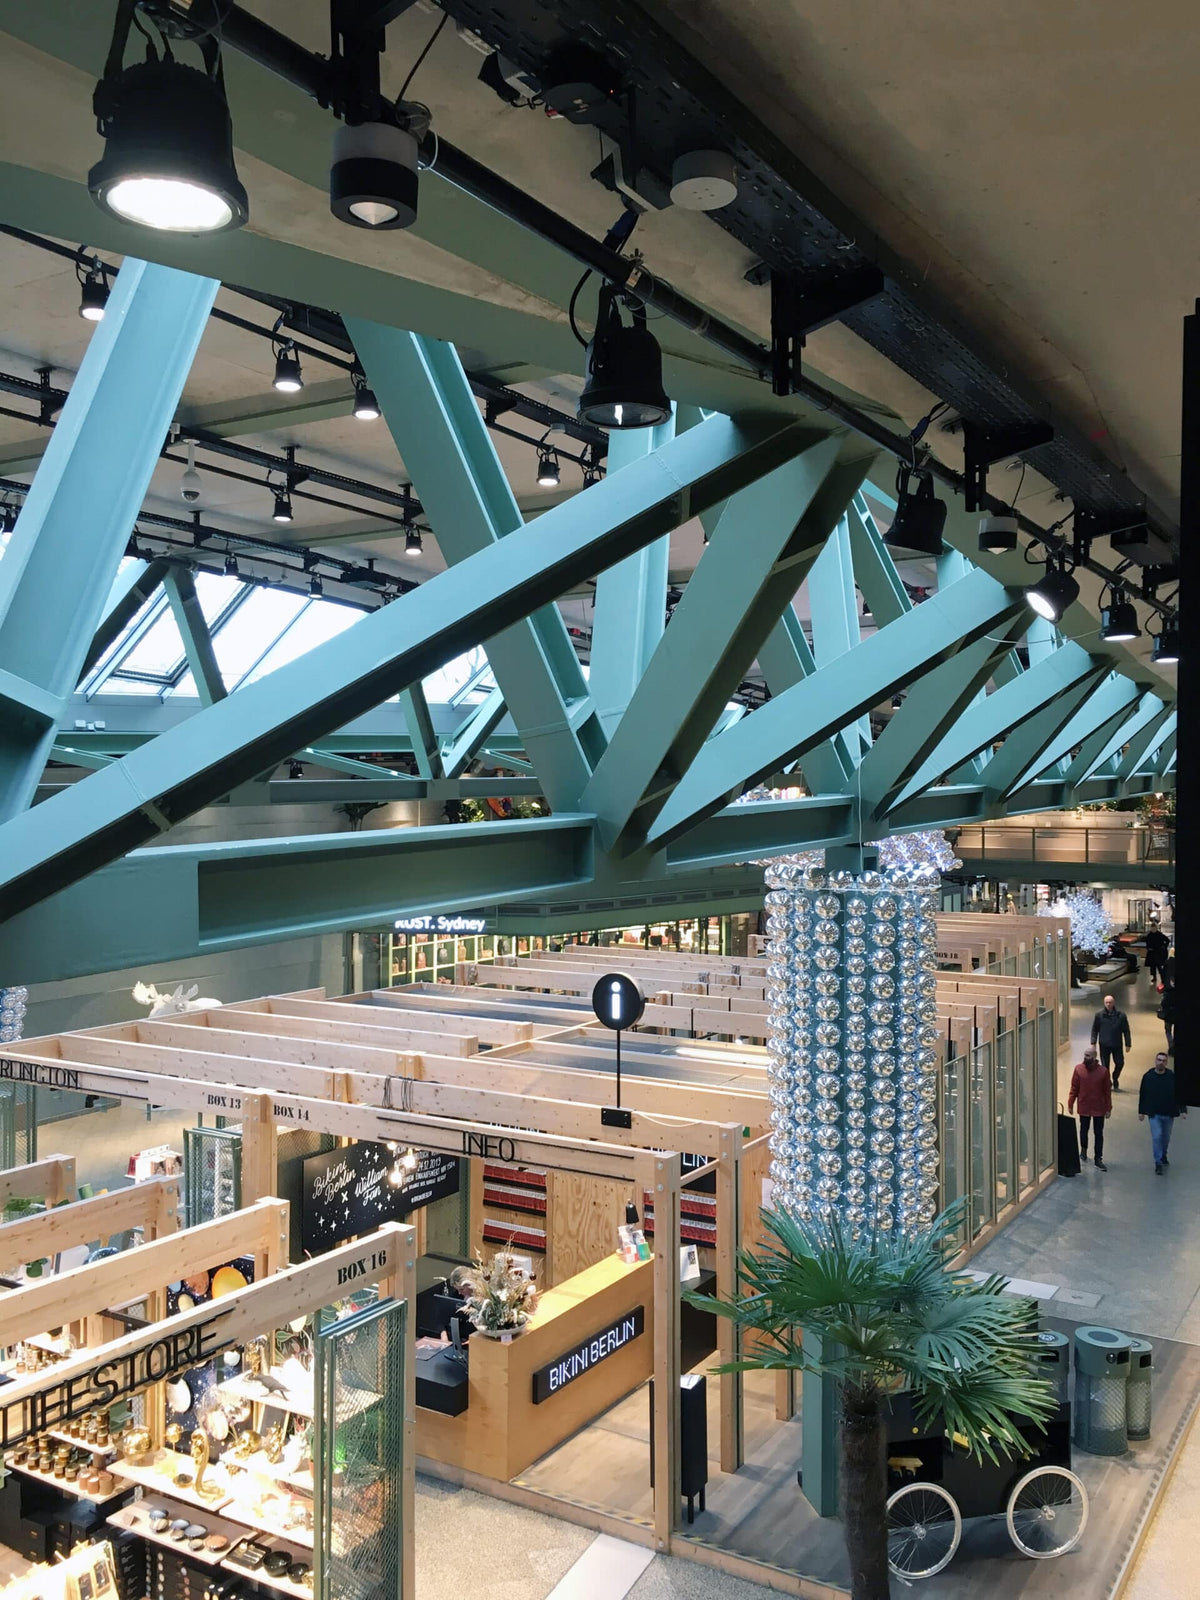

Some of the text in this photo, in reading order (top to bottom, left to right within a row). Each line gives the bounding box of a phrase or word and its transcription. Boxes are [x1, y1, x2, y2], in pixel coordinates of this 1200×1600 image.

[437, 915, 486, 932] Sydney
[207, 1094, 242, 1110] BOX 13
[273, 1104, 309, 1121] BOX 14
[462, 1131, 516, 1163] INFO
[312, 1156, 348, 1200] Bikini
[324, 1168, 357, 1206] Berlin
[354, 1166, 389, 1198] William
[362, 1185, 382, 1207] Fan
[337, 1249, 387, 1286] BOX 16
[549, 1316, 635, 1391] BIKINI BERLIN
